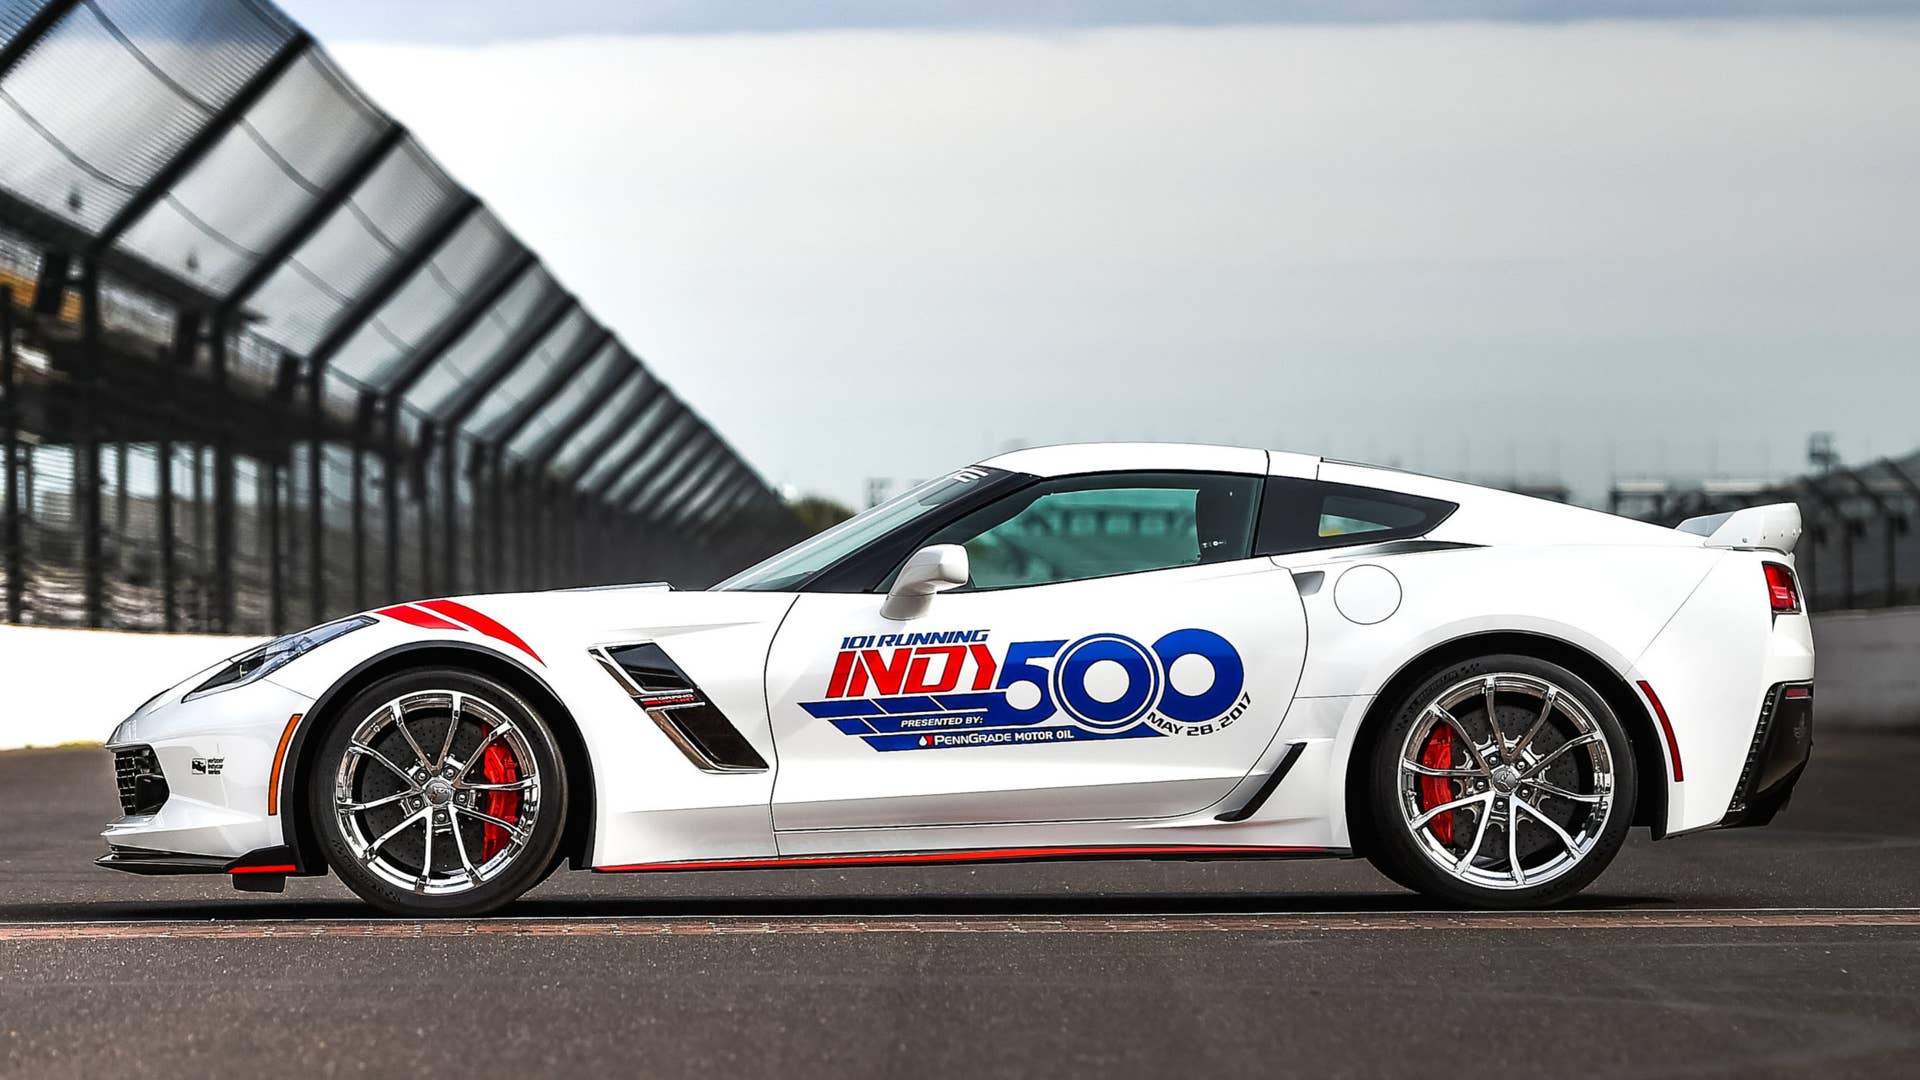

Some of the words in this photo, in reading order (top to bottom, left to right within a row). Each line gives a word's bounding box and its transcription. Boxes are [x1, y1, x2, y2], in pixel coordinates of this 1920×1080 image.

[840, 635, 876, 650] 101
[877, 629, 991, 648] RUNNING
[825, 644, 998, 699] INDY
[996, 628, 1245, 728] 500
[900, 716, 963, 728] PRESENTED
[965, 715, 984, 725] BY:
[1146, 711, 1185, 735] MAY
[1014, 730, 1054, 742] MOTOR
[1056, 730, 1075, 740] OIL
